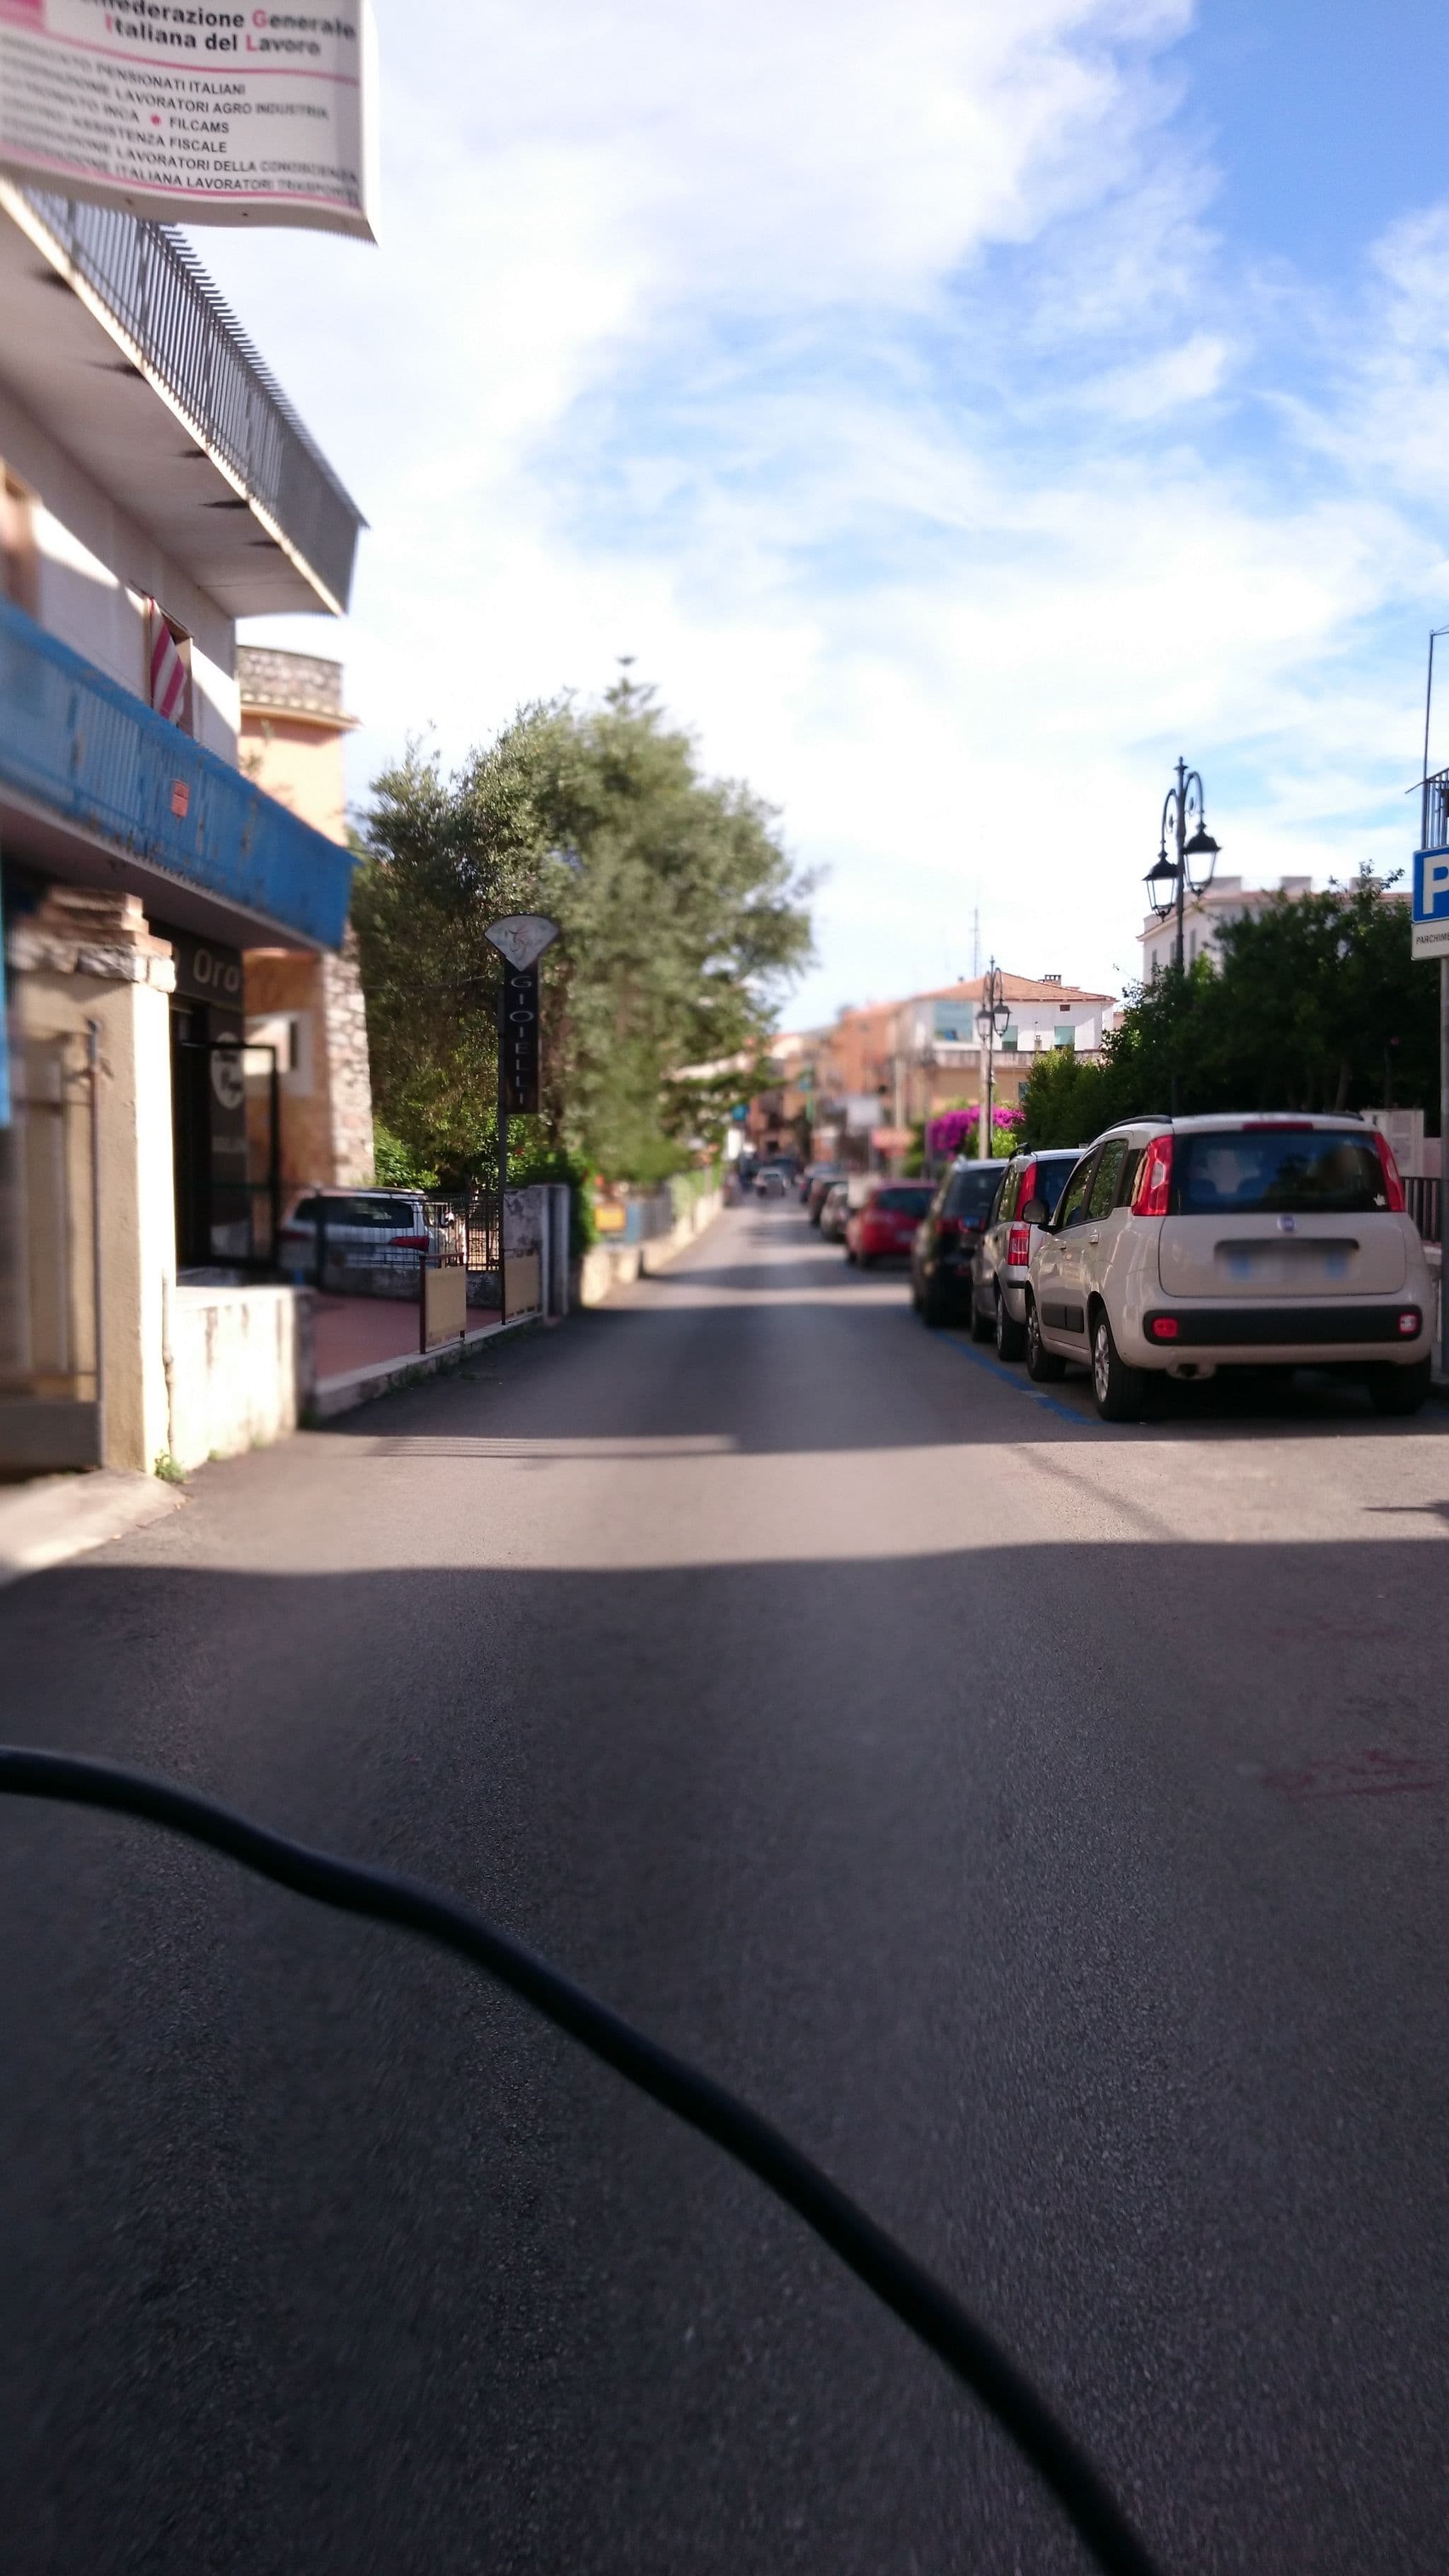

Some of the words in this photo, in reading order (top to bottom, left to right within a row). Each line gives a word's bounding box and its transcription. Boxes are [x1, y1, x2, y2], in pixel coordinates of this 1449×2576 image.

[105, 13, 197, 48] Italiana
[204, 33, 238, 51] del
[245, 35, 321, 56] Lavoro
[252, 9, 357, 40] Generale
[96, 61, 185, 92] PENSIONATI
[189, 81, 246, 95] ITALIANI
[115, 88, 209, 113] LAVORATORI
[213, 103, 253, 115] AGRO
[169, 116, 230, 134] FILCAMS
[115, 146, 209, 171] LAVORATORI
[214, 160, 257, 173] DELLA
[169, 137, 227, 153] FISCALE
[115, 163, 183, 187] ITALIANA
[186, 176, 273, 190] LAVORATORI
[1423, 854, 1449, 914] P
[193, 949, 240, 993] Oro
[509, 976, 534, 1105] GIOIELLI
